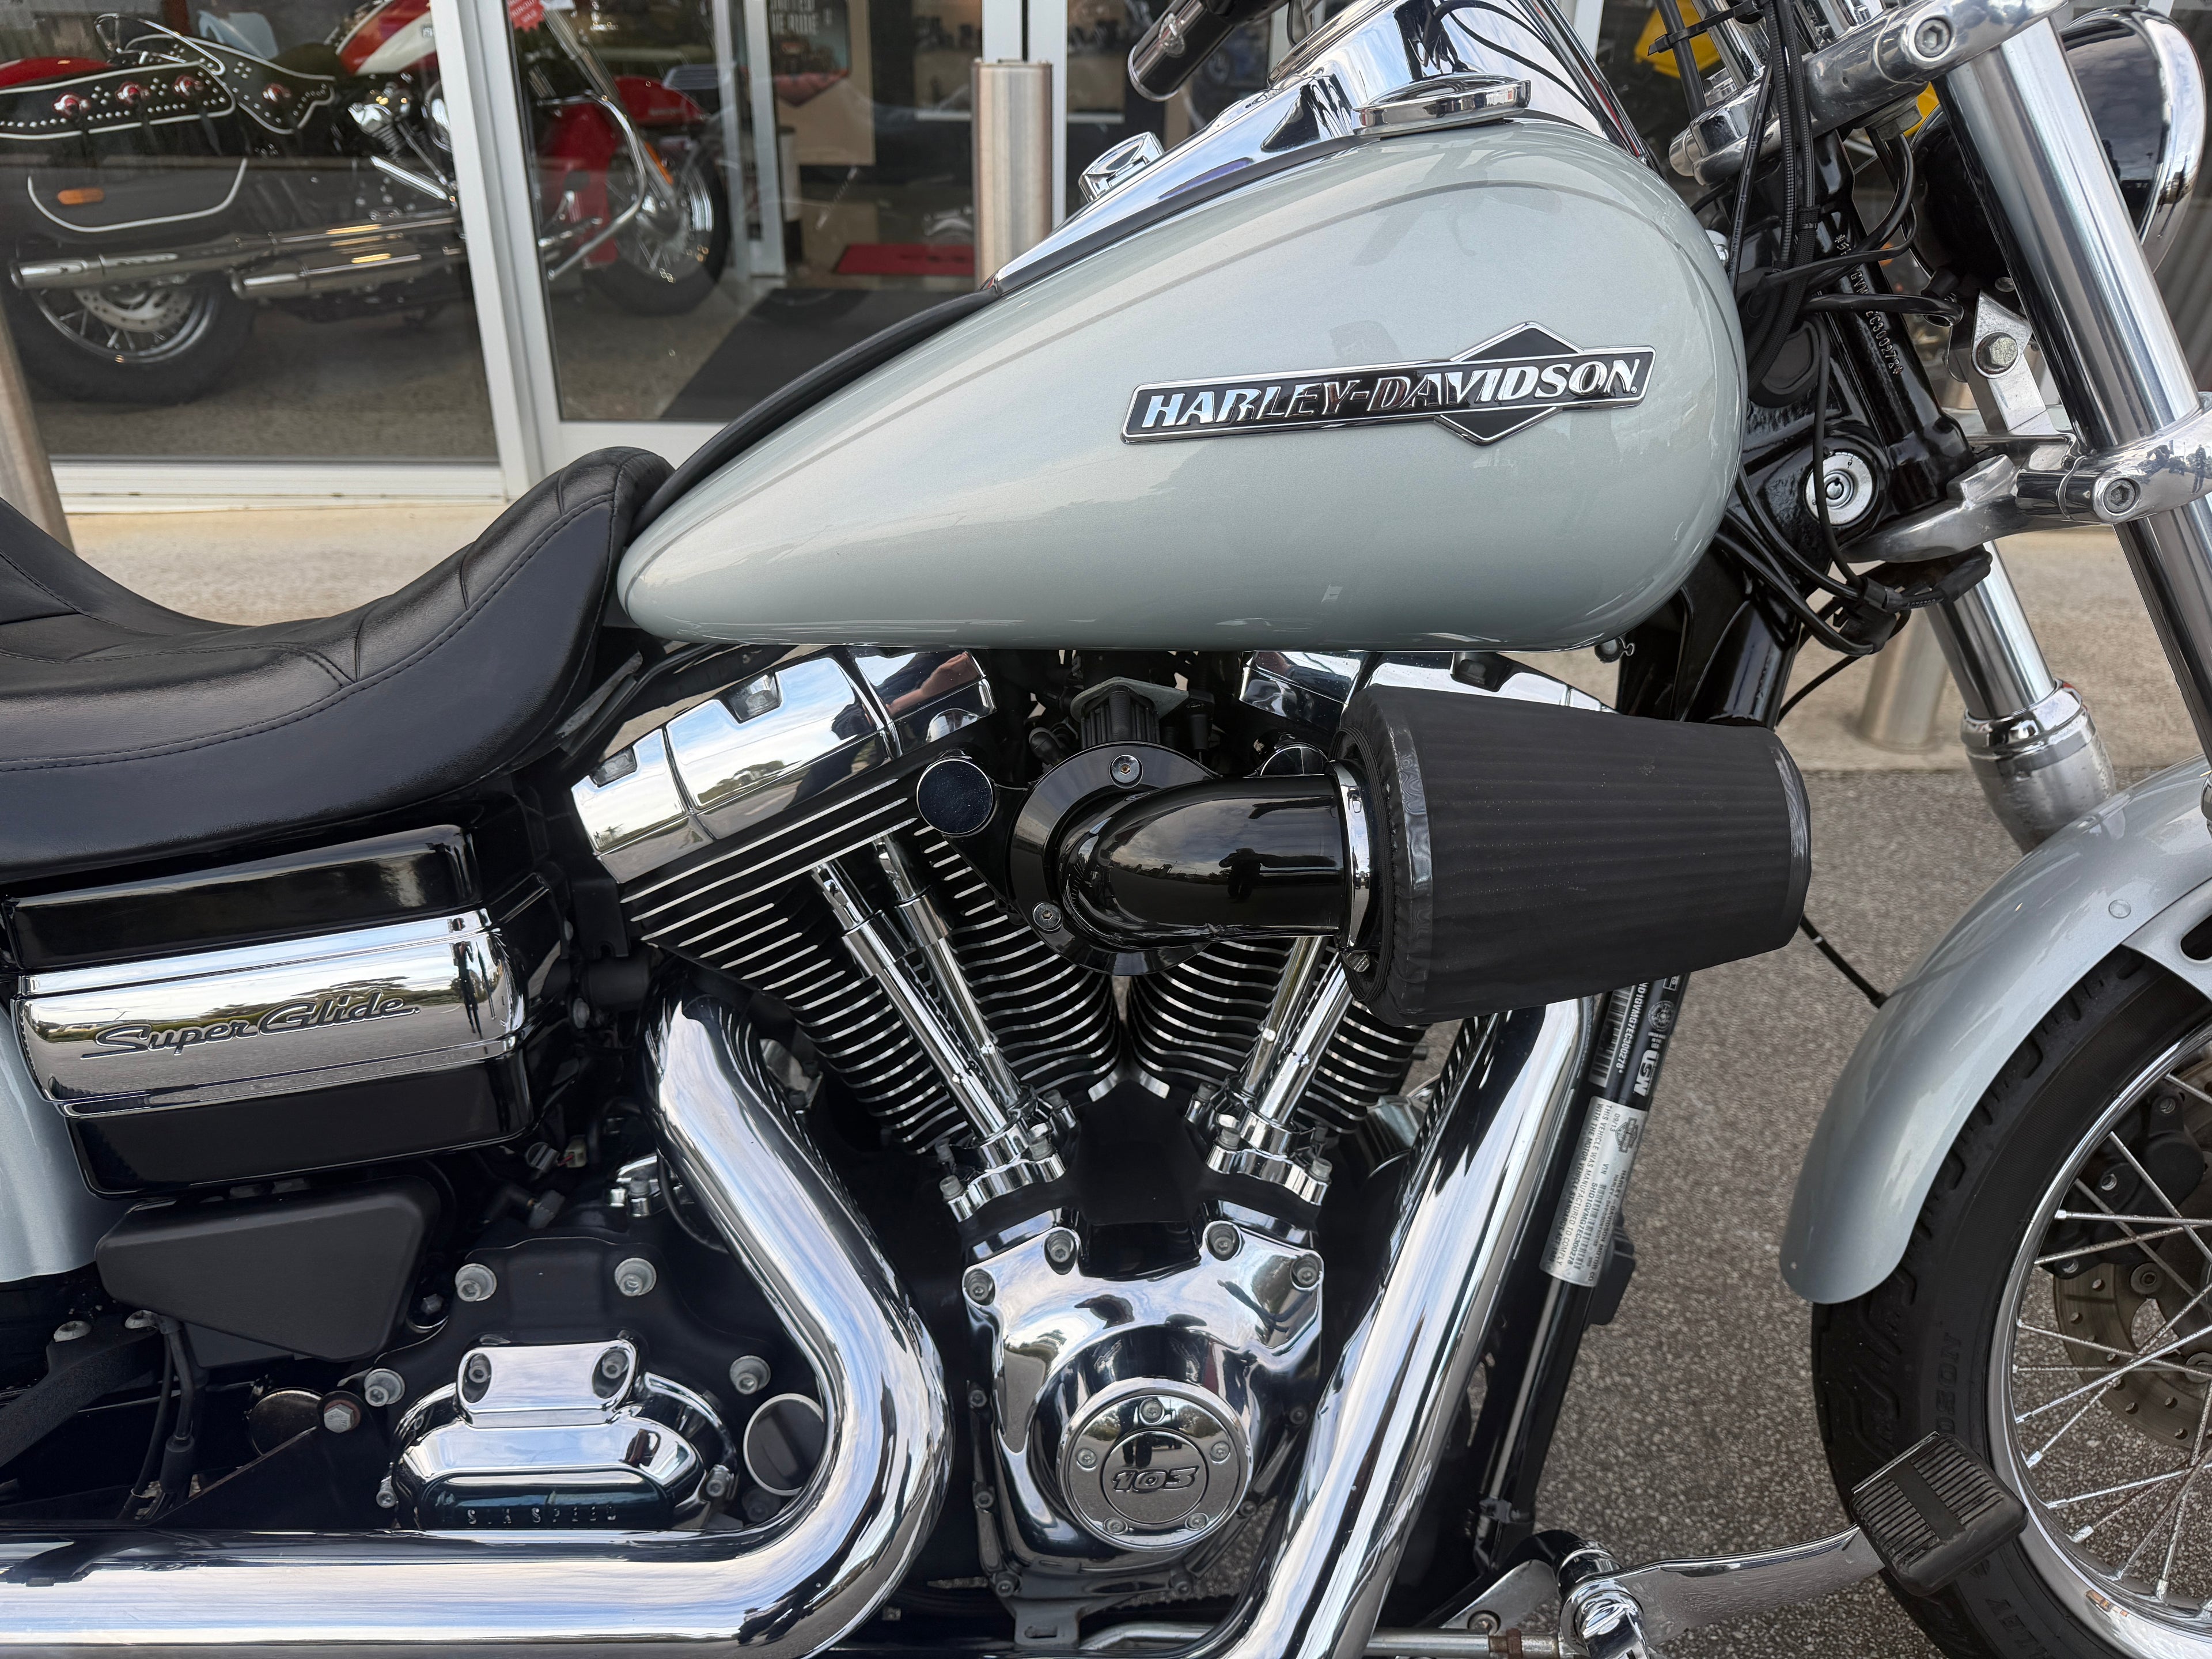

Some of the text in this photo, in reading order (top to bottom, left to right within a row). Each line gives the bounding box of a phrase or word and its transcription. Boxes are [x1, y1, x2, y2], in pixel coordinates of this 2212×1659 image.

[1142, 359, 1633, 428] HARLEY-DAVIDSON
[81, 988, 420, 1055] Super Glide
[1634, 1050, 1657, 1096] USW
[1592, 1103, 1603, 1121] WITH
[1609, 1112, 1620, 1132] 09/13
[1588, 1122, 1597, 1135] THE
[1580, 1137, 1592, 1161] MOTOR
[1571, 1162, 1584, 1190] VEHICLE
[1600, 1162, 1609, 1175] VIN
[1555, 1104, 1612, 1265] THIS VEHICLE WAS MANUFACTURED TO COMPLY
[1558, 1191, 1575, 1230] STANDARDS
[1554, 1232, 1563, 1245] ACT
[1112, 1465, 1199, 1493] 103
